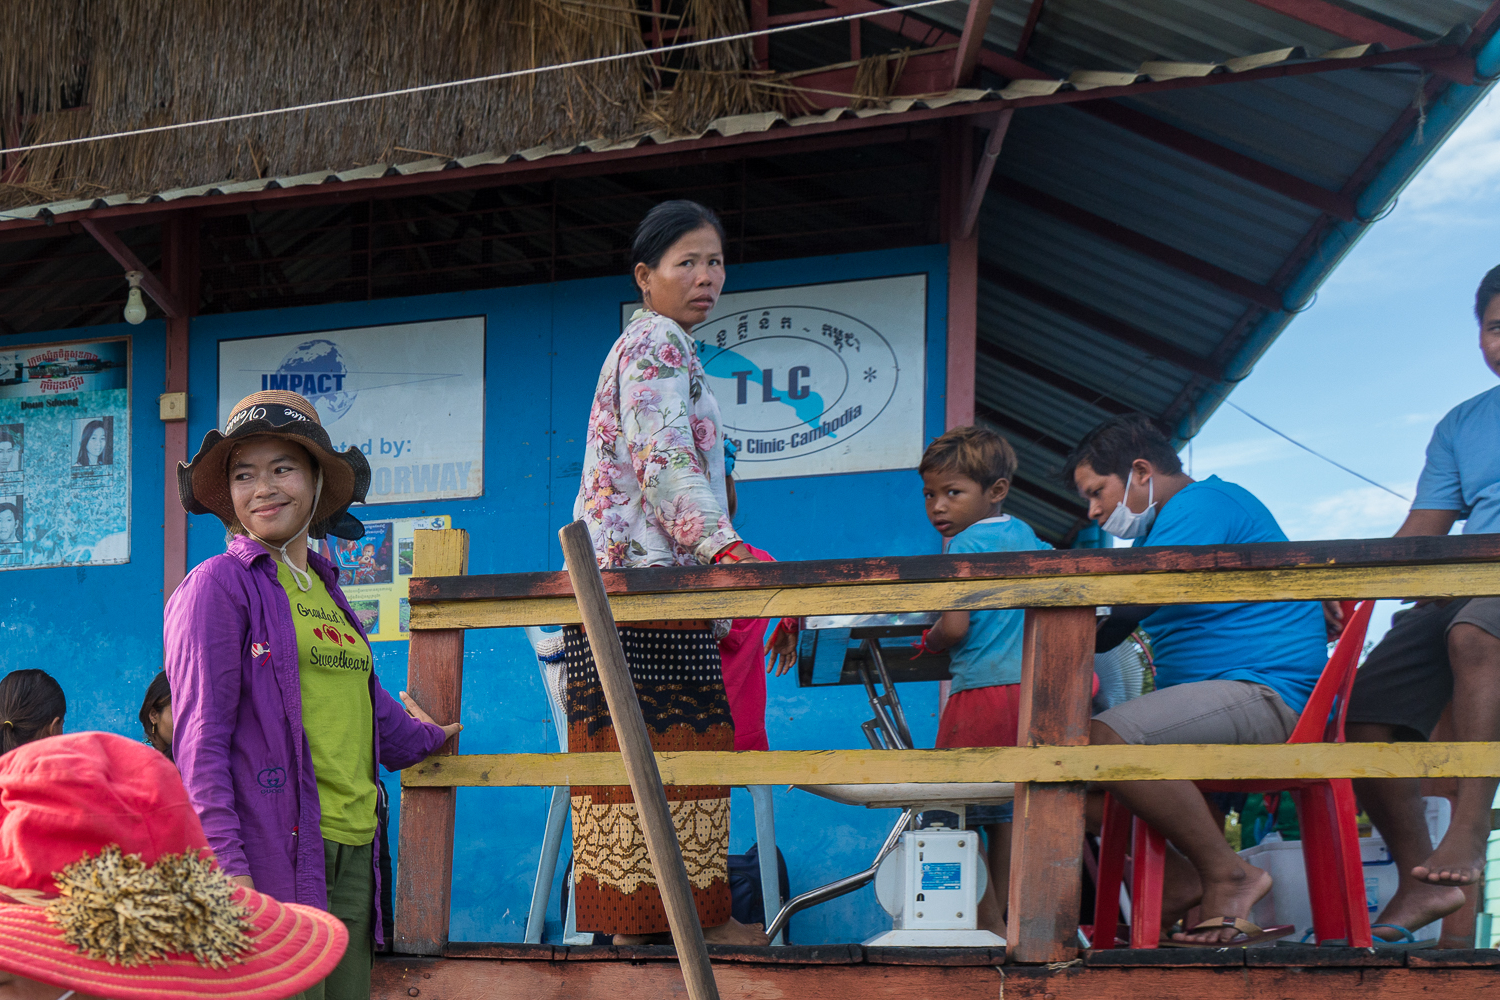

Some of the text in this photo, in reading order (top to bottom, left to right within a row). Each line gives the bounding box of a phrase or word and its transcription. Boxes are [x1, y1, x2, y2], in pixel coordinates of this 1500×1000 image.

[261, 374, 346, 396] IMPACT
[732, 365, 810, 405] TLC
[747, 404, 862, 454] Clinic-Cambodia
[380, 437, 412, 458] by:
[297, 603, 346, 626] Grandad's
[309, 645, 370, 672] Sweetheart
